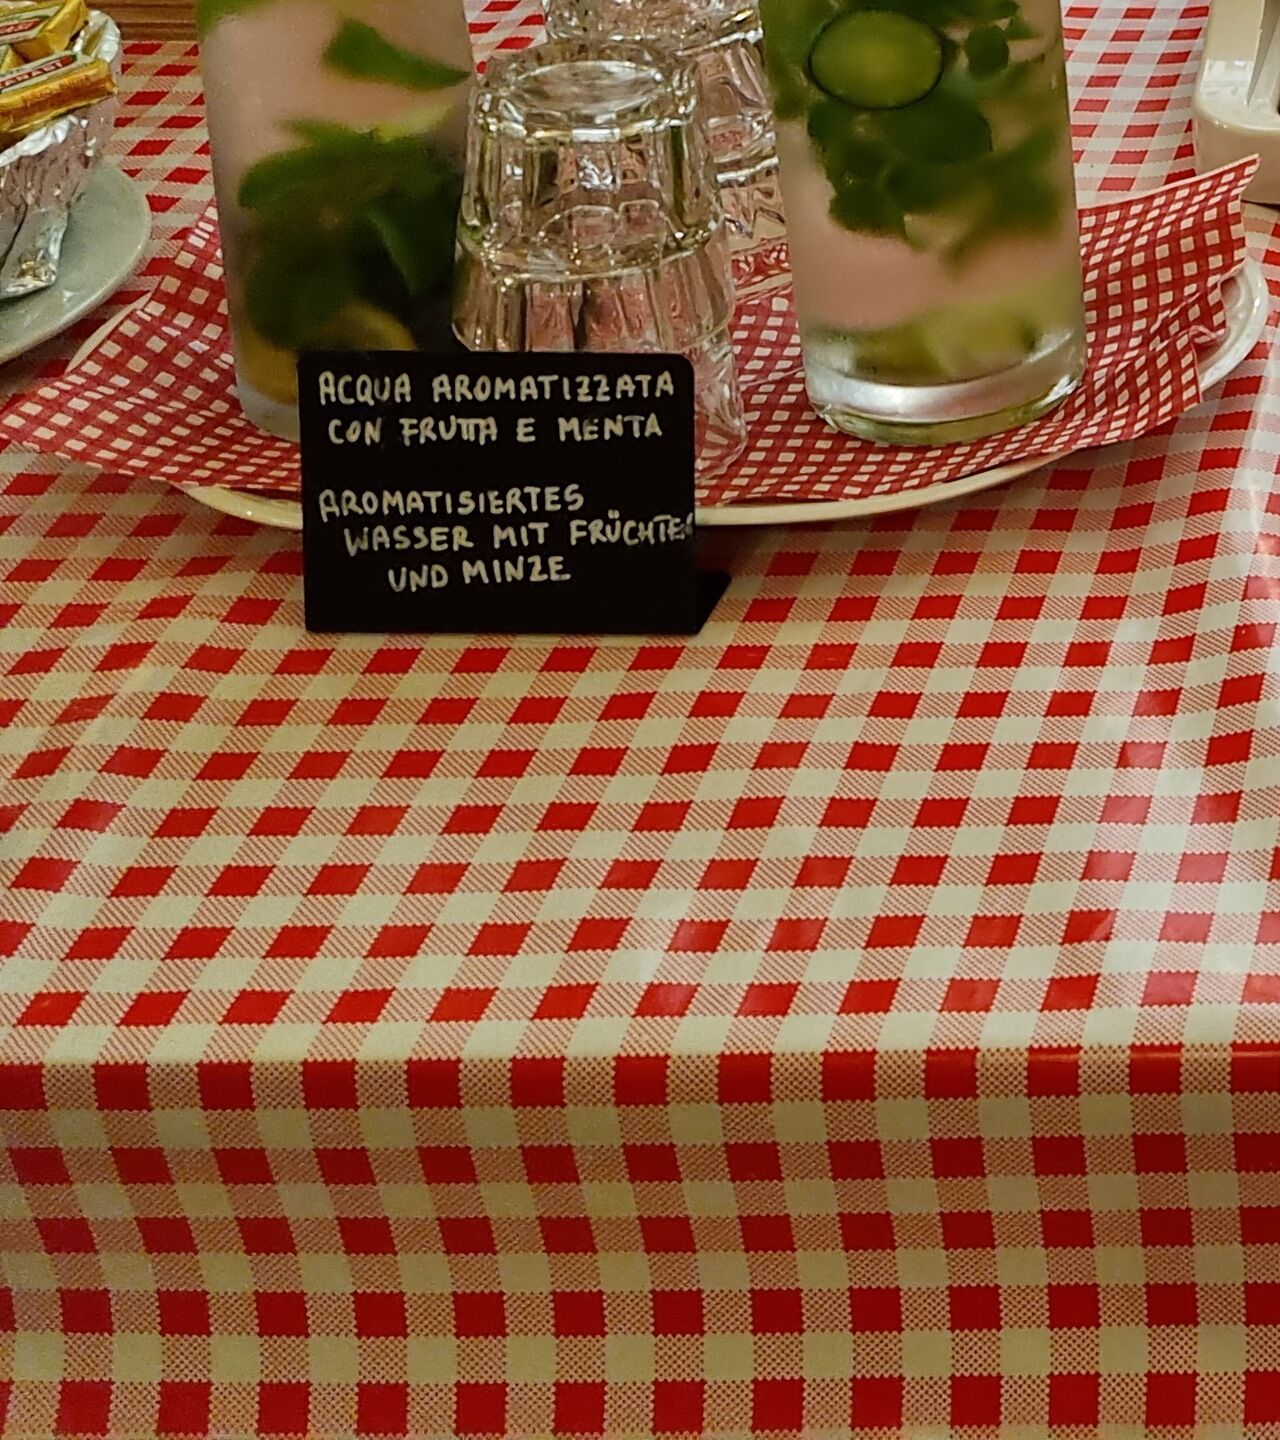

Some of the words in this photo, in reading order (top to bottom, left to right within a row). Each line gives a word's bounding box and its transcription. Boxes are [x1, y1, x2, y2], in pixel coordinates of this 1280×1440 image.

[318, 371, 412, 406] ACQUA
[431, 370, 674, 403] AROMATIZZATA
[328, 417, 382, 446] CON
[398, 414, 498, 447] FRUTTA
[516, 417, 536, 443] E
[557, 412, 663, 442] MENTA
[319, 483, 588, 525] AROMATISIERTES
[343, 524, 475, 557] WASSER
[493, 522, 550, 549] MIT
[388, 564, 449, 593] UND
[462, 555, 572, 584] MINZE
